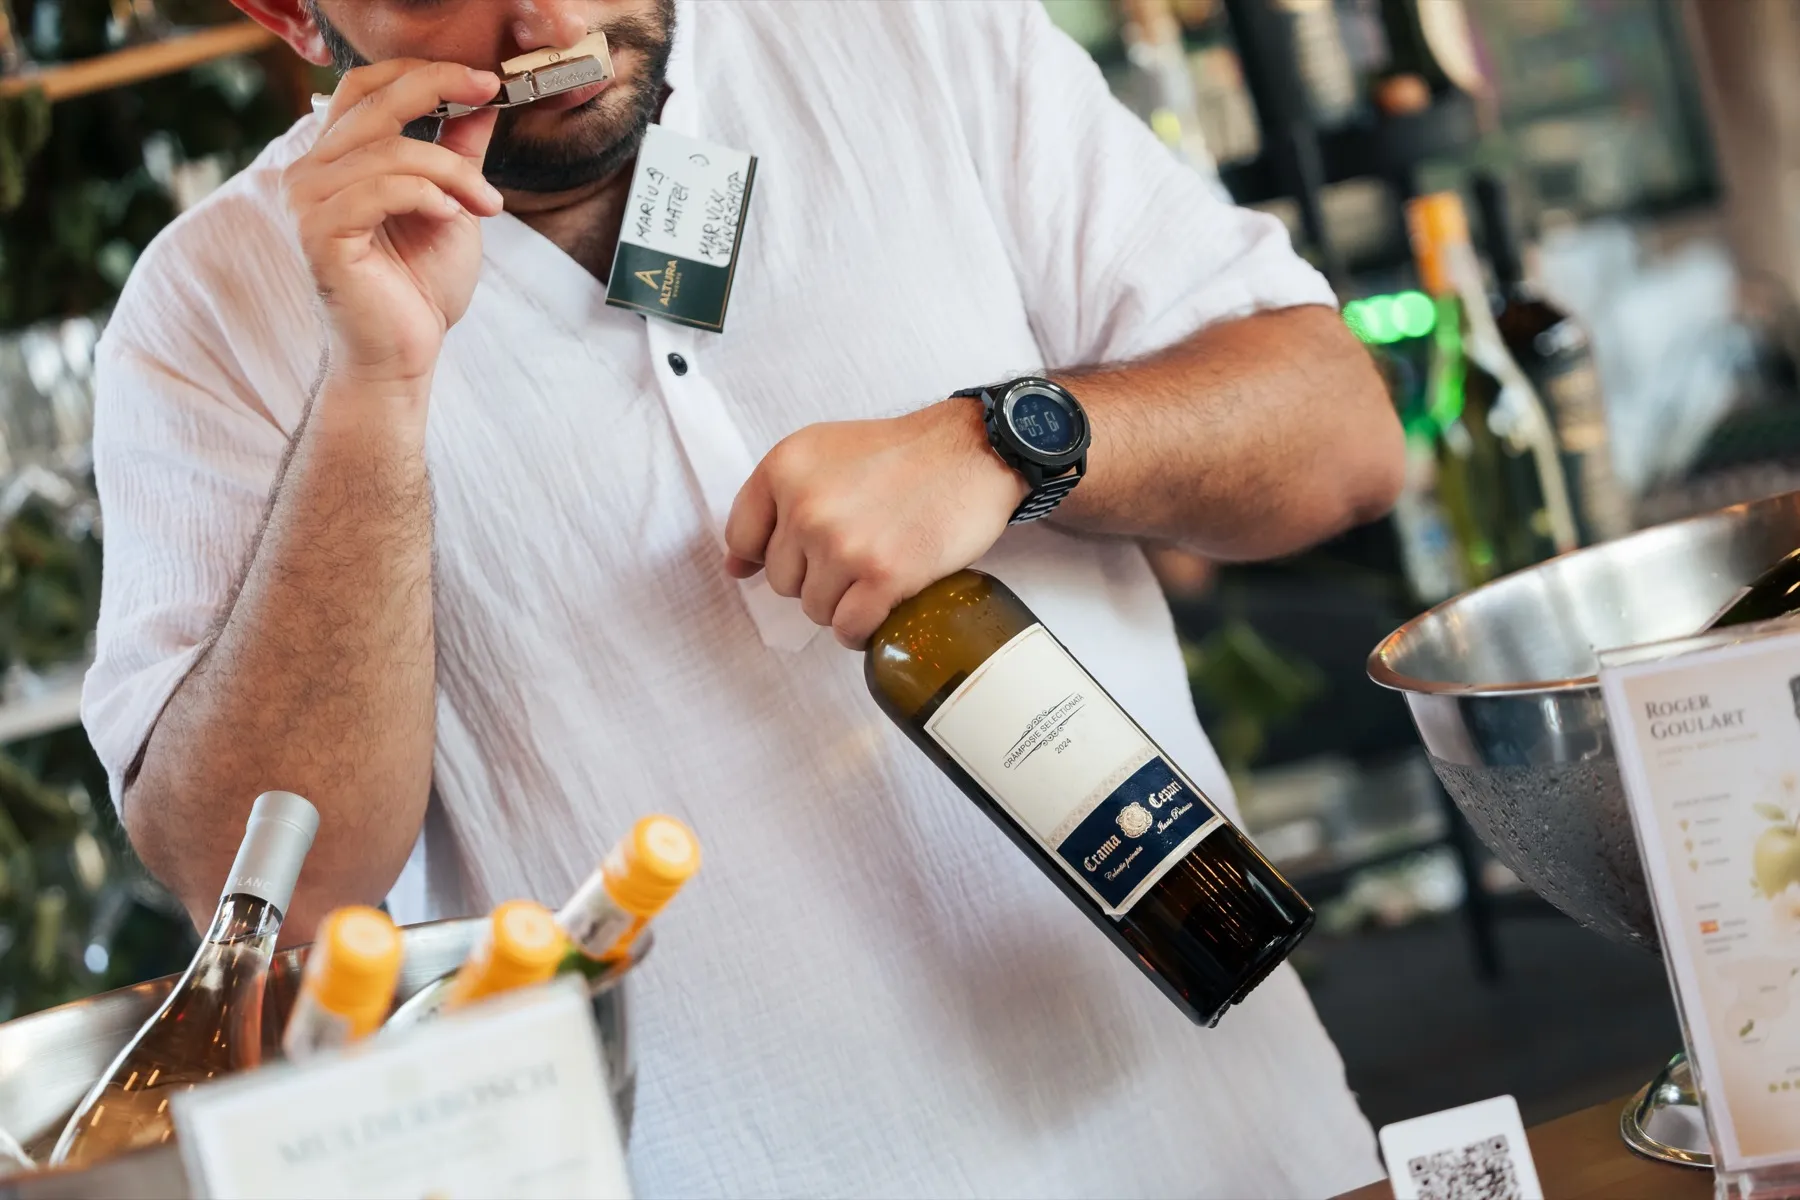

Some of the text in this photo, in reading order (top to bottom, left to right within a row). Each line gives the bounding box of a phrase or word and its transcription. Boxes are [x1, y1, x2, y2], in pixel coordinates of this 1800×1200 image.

[636, 166, 665, 243] MARIUS
[659, 259, 678, 307] ALTURA
[1644, 694, 1711, 720] ROGER
[1650, 708, 1745, 740] GOULART
[1054, 738, 1072, 754] 2024
[1083, 778, 1183, 872] Crama Cepari
[234, 876, 272, 892] LANC
